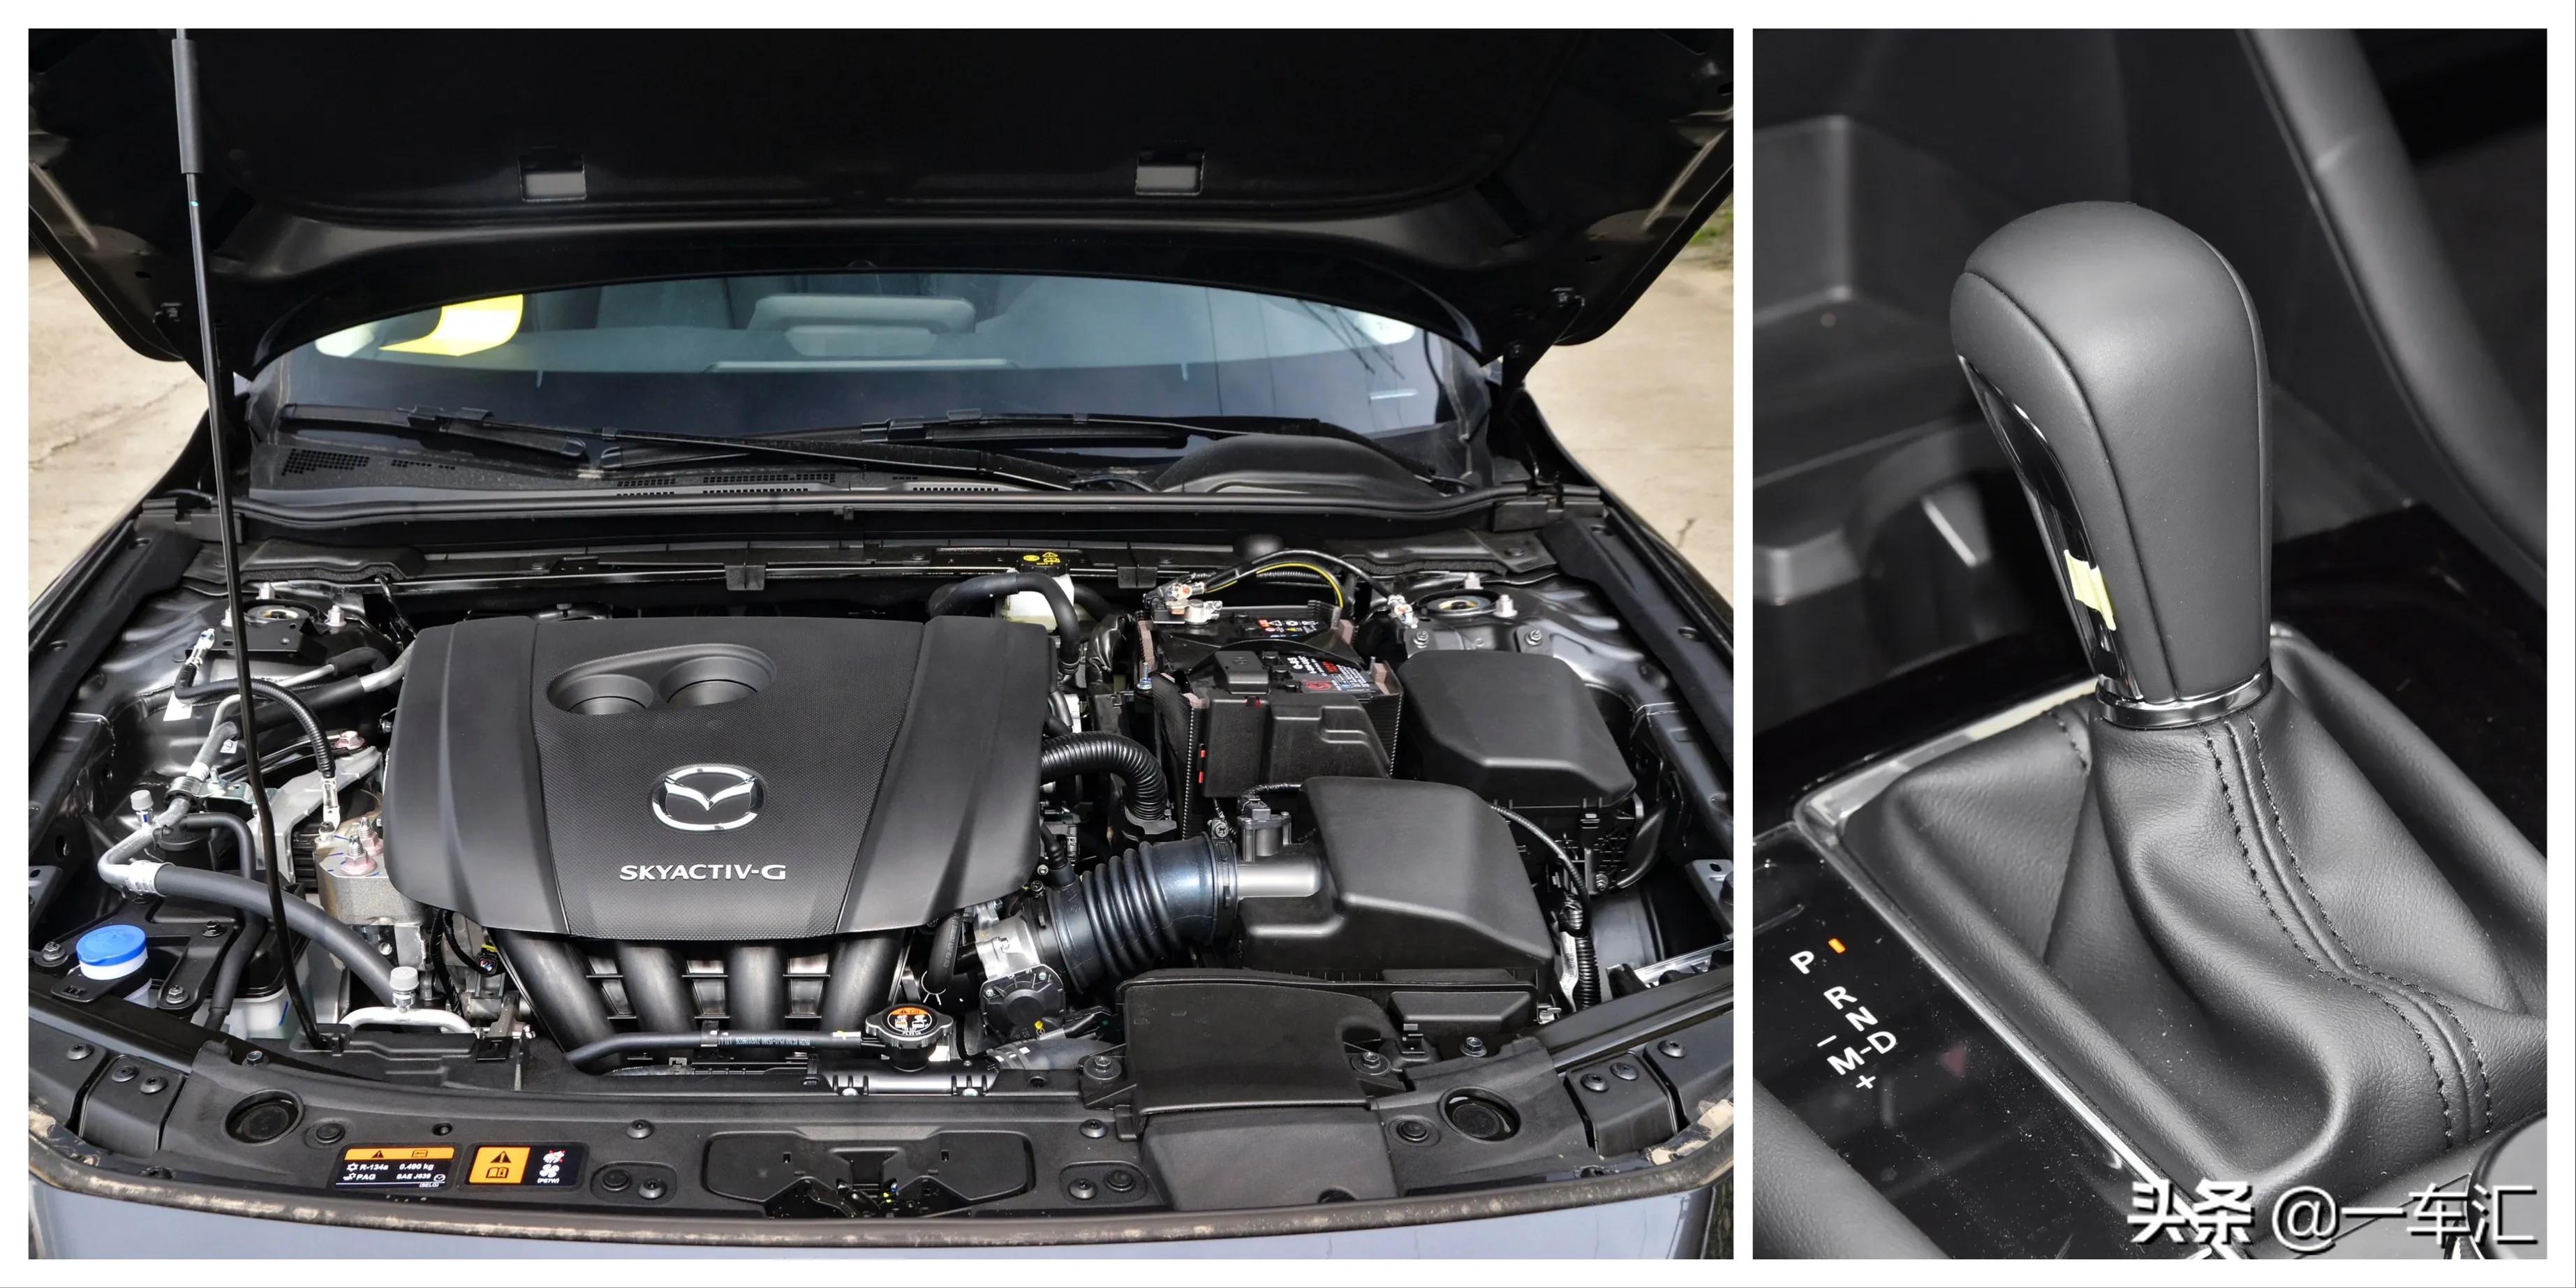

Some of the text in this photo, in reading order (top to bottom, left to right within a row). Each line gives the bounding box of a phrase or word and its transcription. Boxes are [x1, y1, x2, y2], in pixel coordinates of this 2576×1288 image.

[620, 864, 787, 881] SKYACTIV-G
[1789, 950, 1814, 975] P
[1823, 986, 1858, 1009] R
[1845, 1006, 1878, 1032] N
